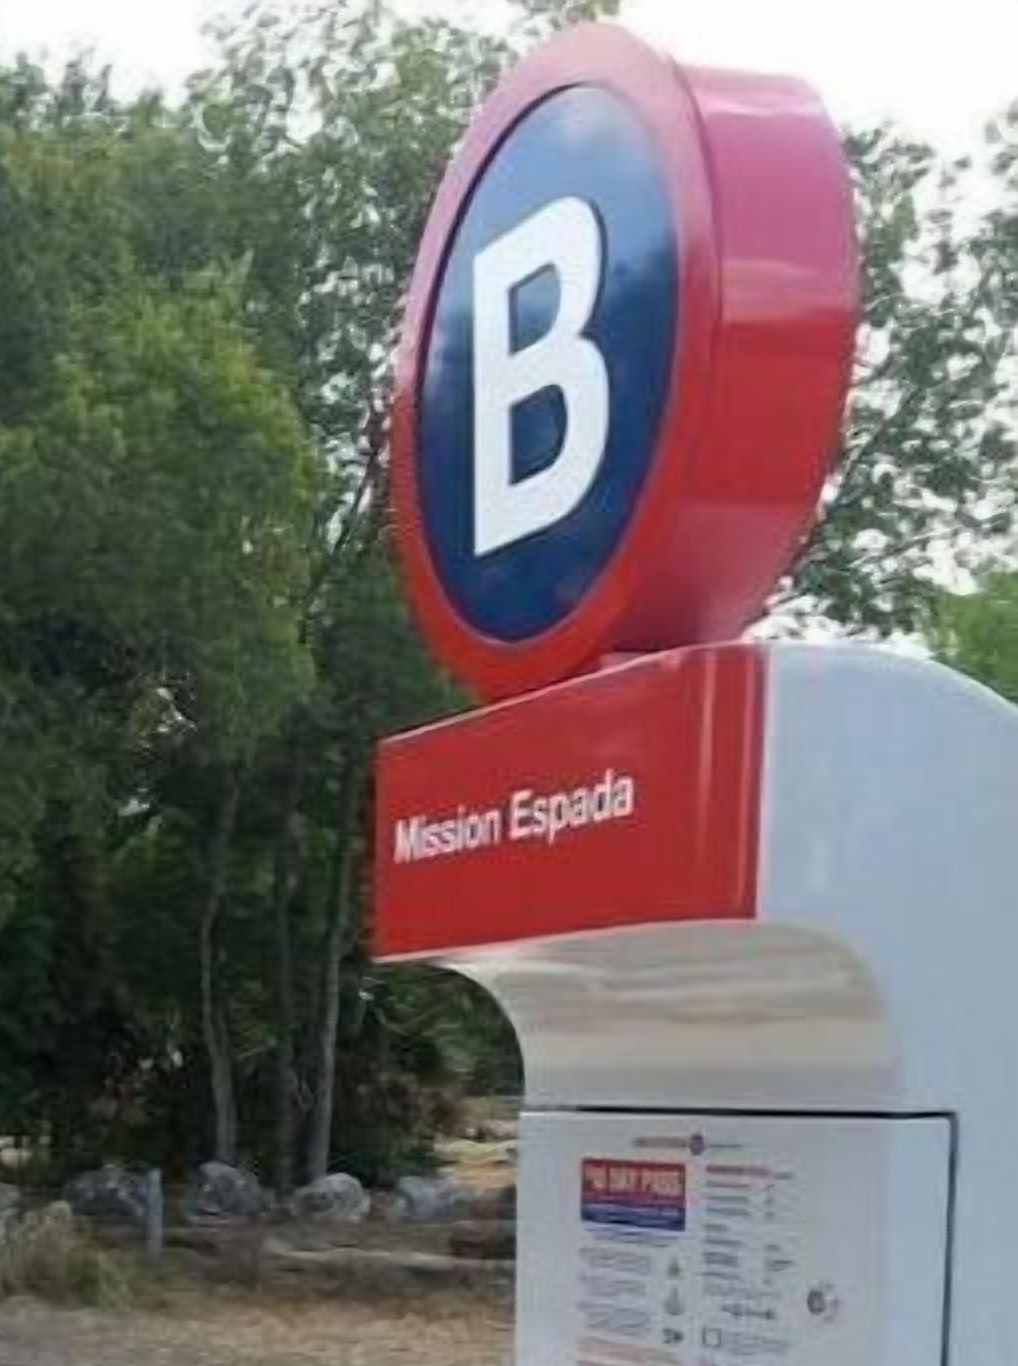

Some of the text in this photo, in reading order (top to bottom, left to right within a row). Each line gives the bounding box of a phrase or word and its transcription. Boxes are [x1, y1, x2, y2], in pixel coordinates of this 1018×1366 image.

[473, 195, 610, 557] B
[393, 768, 635, 865] Mission Espada
